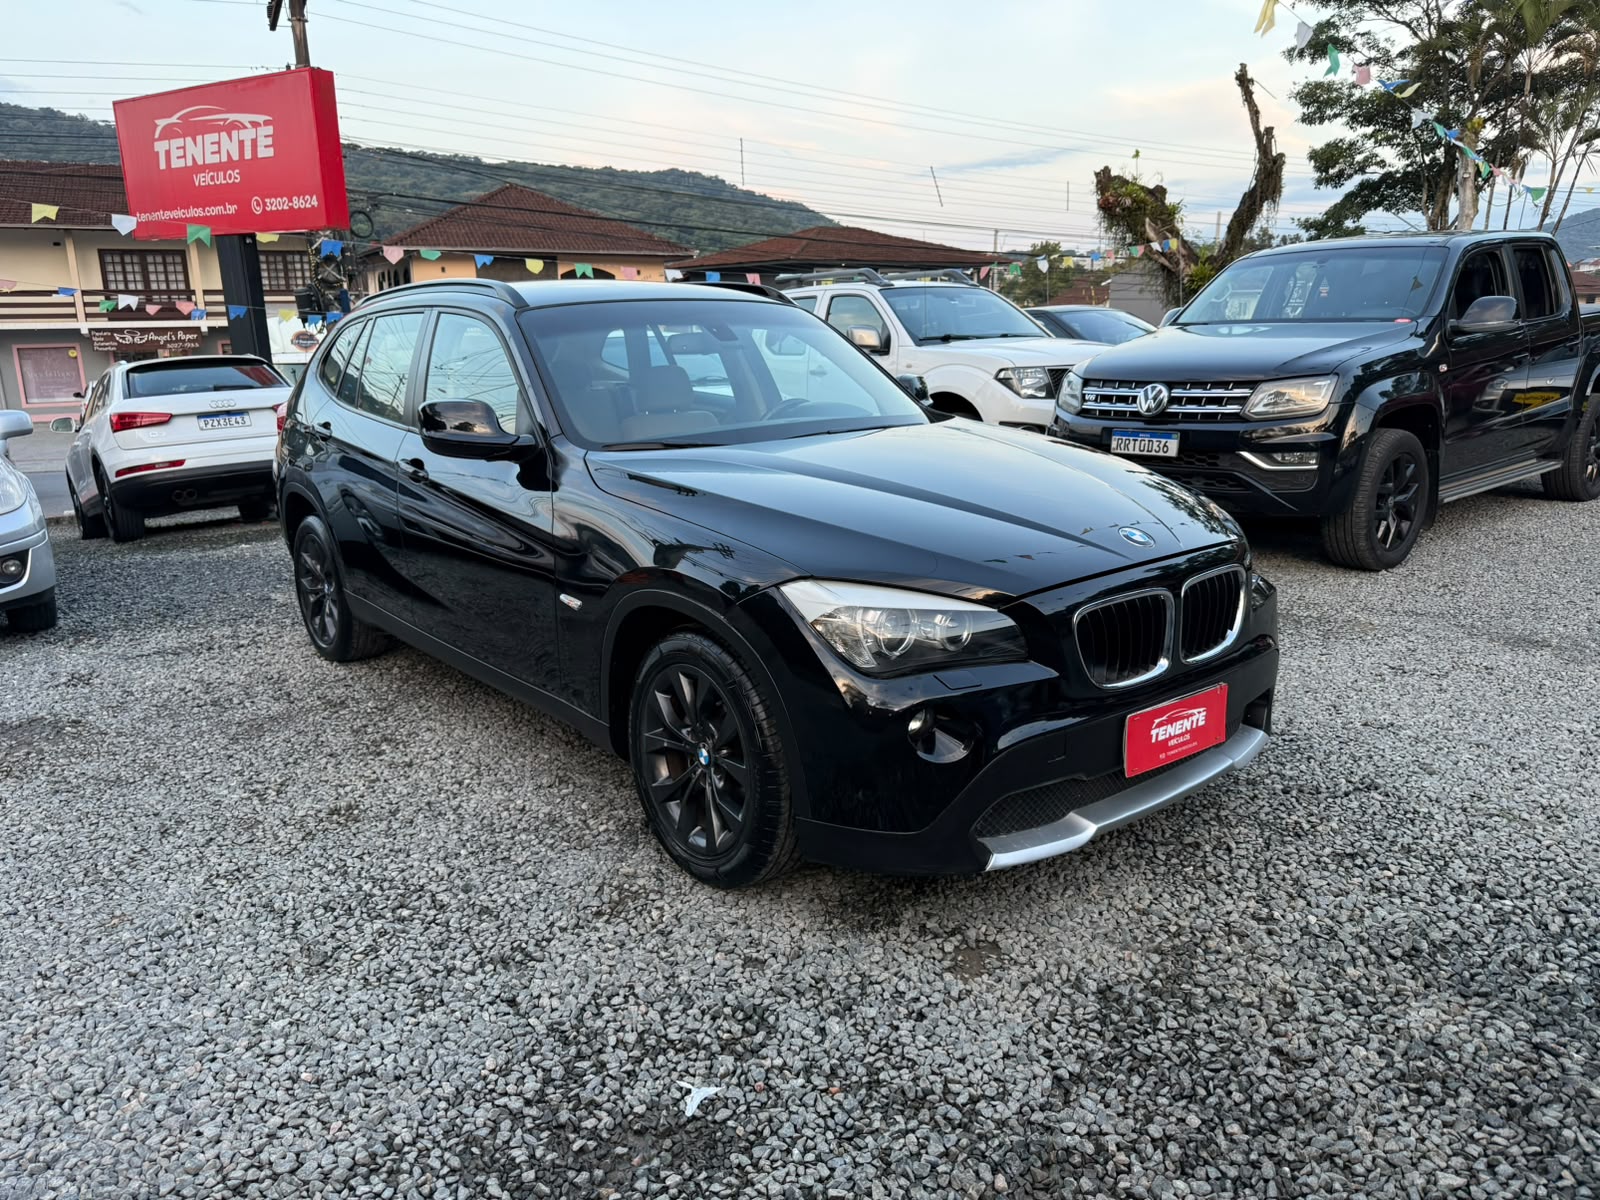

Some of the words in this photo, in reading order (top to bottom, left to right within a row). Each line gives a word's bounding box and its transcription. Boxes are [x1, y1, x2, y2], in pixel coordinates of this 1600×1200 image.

[153, 125, 275, 170] TENENTE
[193, 169, 241, 187] VEÍCULOS
[136, 202, 238, 222] tenenteveiculos.com.br
[264, 194, 319, 212] 3202-8624
[148, 331, 176, 345] Angel's
[177, 330, 199, 342] Paper
[203, 416, 246, 428] PZX3E43
[1150, 711, 1207, 744] TENENTE
